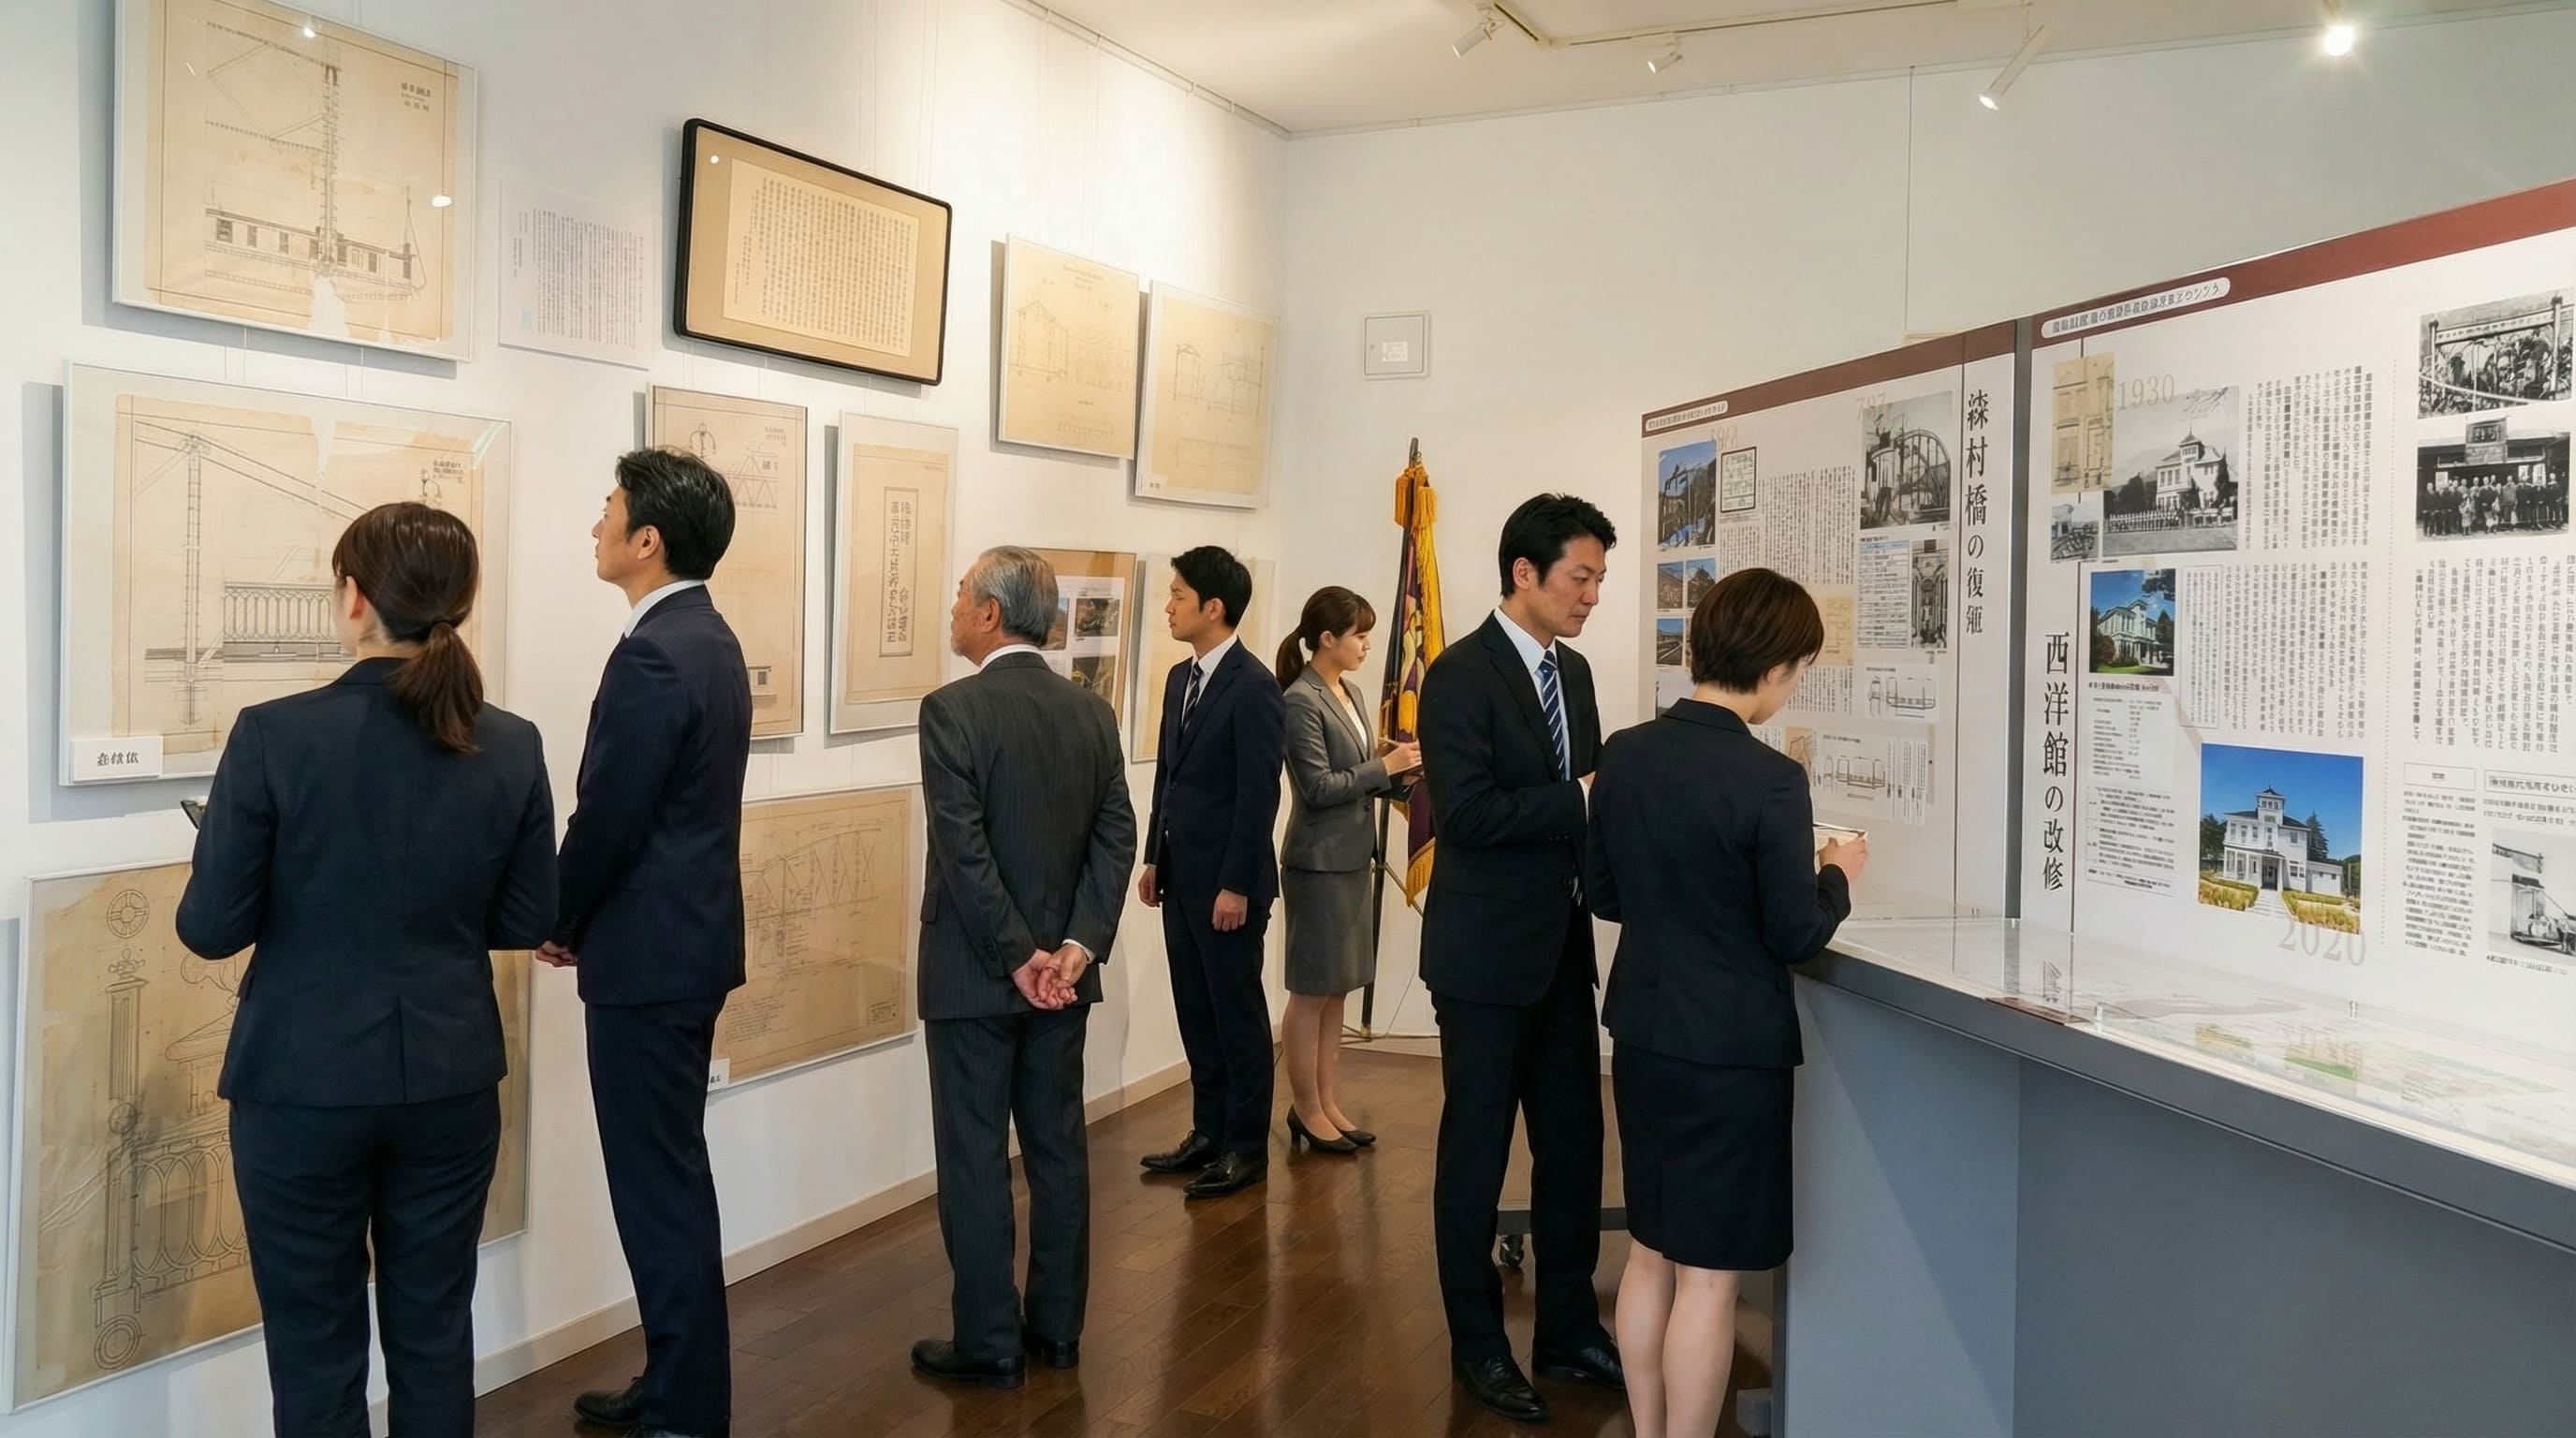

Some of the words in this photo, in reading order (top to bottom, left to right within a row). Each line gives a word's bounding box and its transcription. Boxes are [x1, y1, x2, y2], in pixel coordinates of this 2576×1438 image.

[2118, 374, 2175, 411] 1930
[2042, 631, 2070, 891] 西洋館の改修
[2276, 916, 2366, 967] 2020
